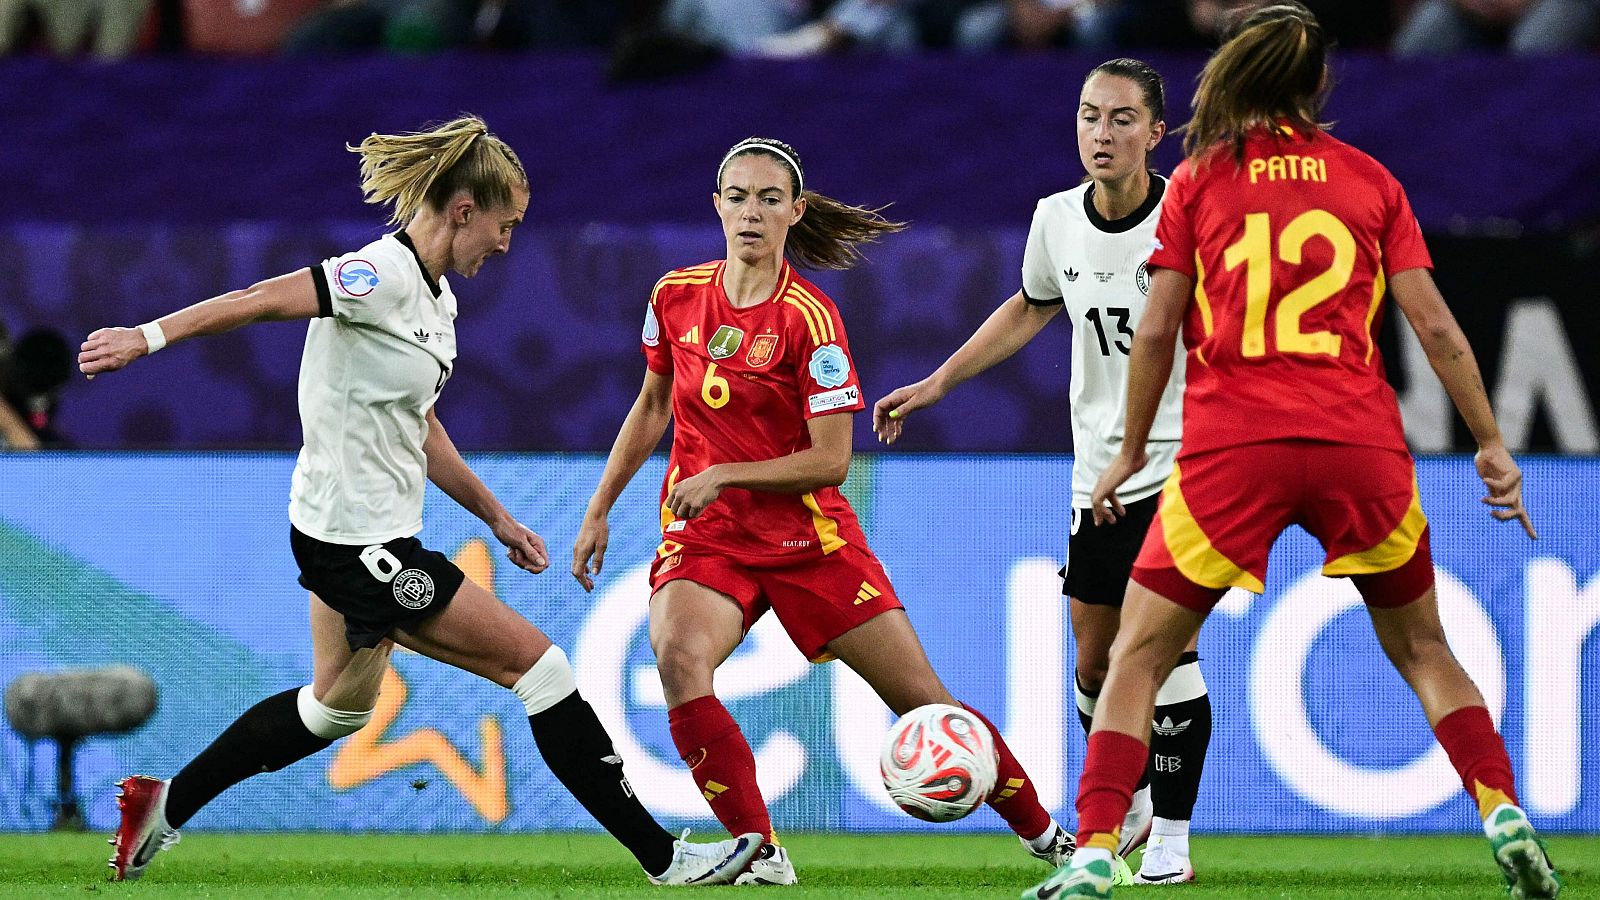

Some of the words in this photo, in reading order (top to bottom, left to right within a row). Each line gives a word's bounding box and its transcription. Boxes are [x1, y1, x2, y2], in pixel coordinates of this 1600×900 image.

[1248, 155, 1328, 185] PATRI
[1223, 208, 1358, 359] 12
[1084, 306, 1135, 356] 13
[701, 361, 730, 410] 6
[845, 389, 858, 400] 10
[358, 544, 403, 584] 6
[782, 539, 811, 549] HEAT.RDY
